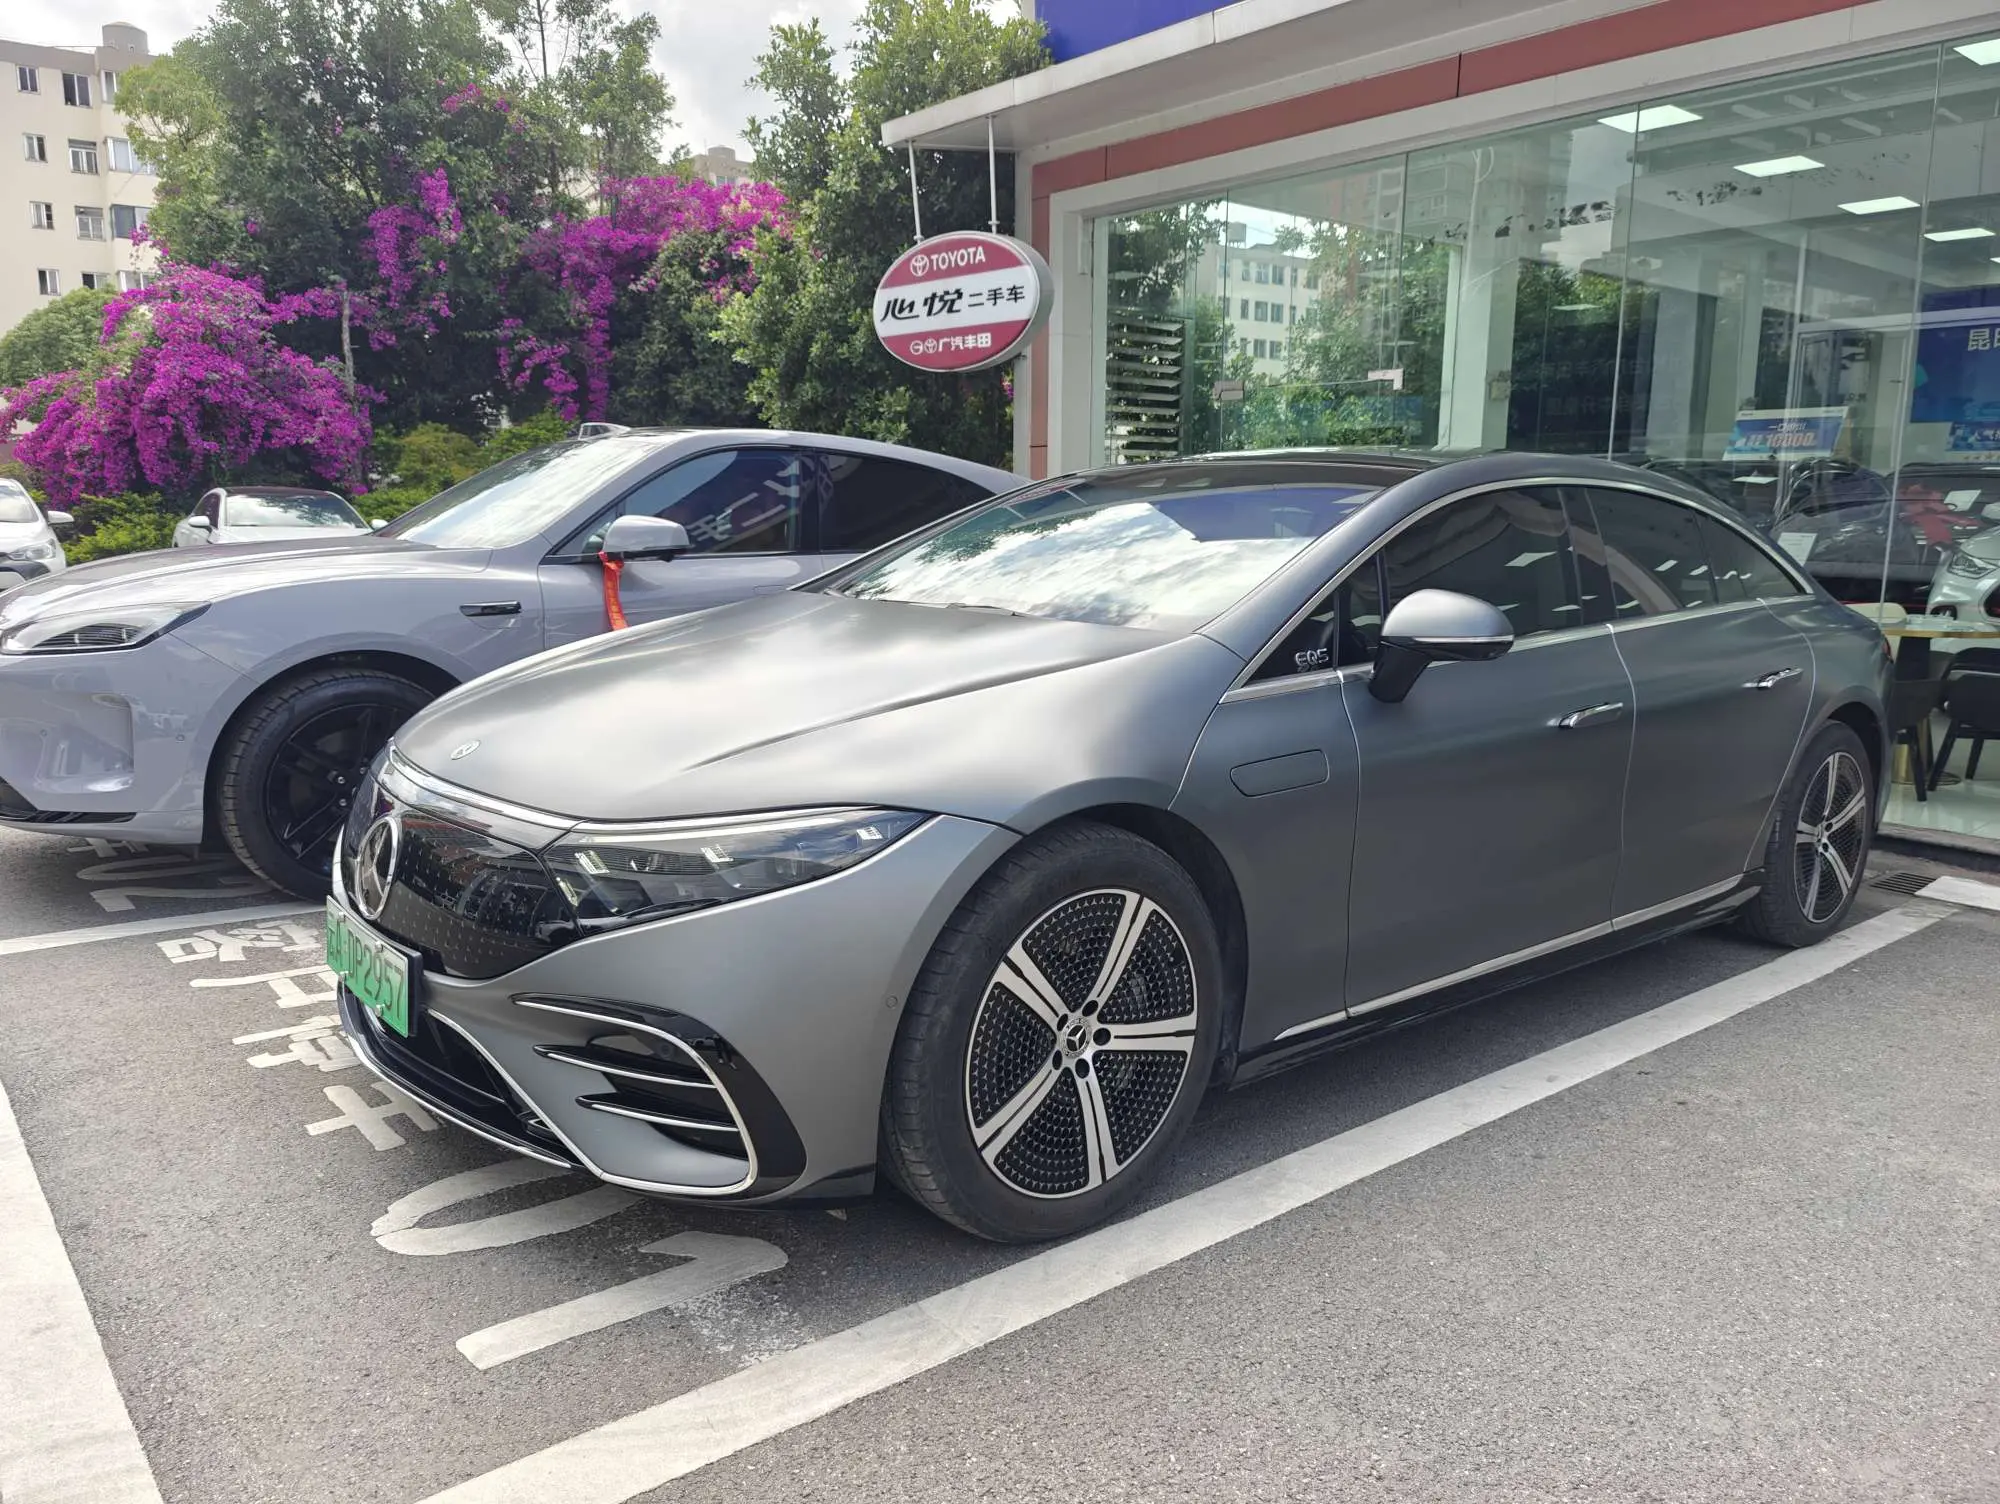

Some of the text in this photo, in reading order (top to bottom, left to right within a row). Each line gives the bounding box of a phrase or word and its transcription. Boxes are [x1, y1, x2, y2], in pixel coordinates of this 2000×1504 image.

[931, 246, 986, 271] TOYOTA
[938, 333, 992, 352] 广汽丰田
